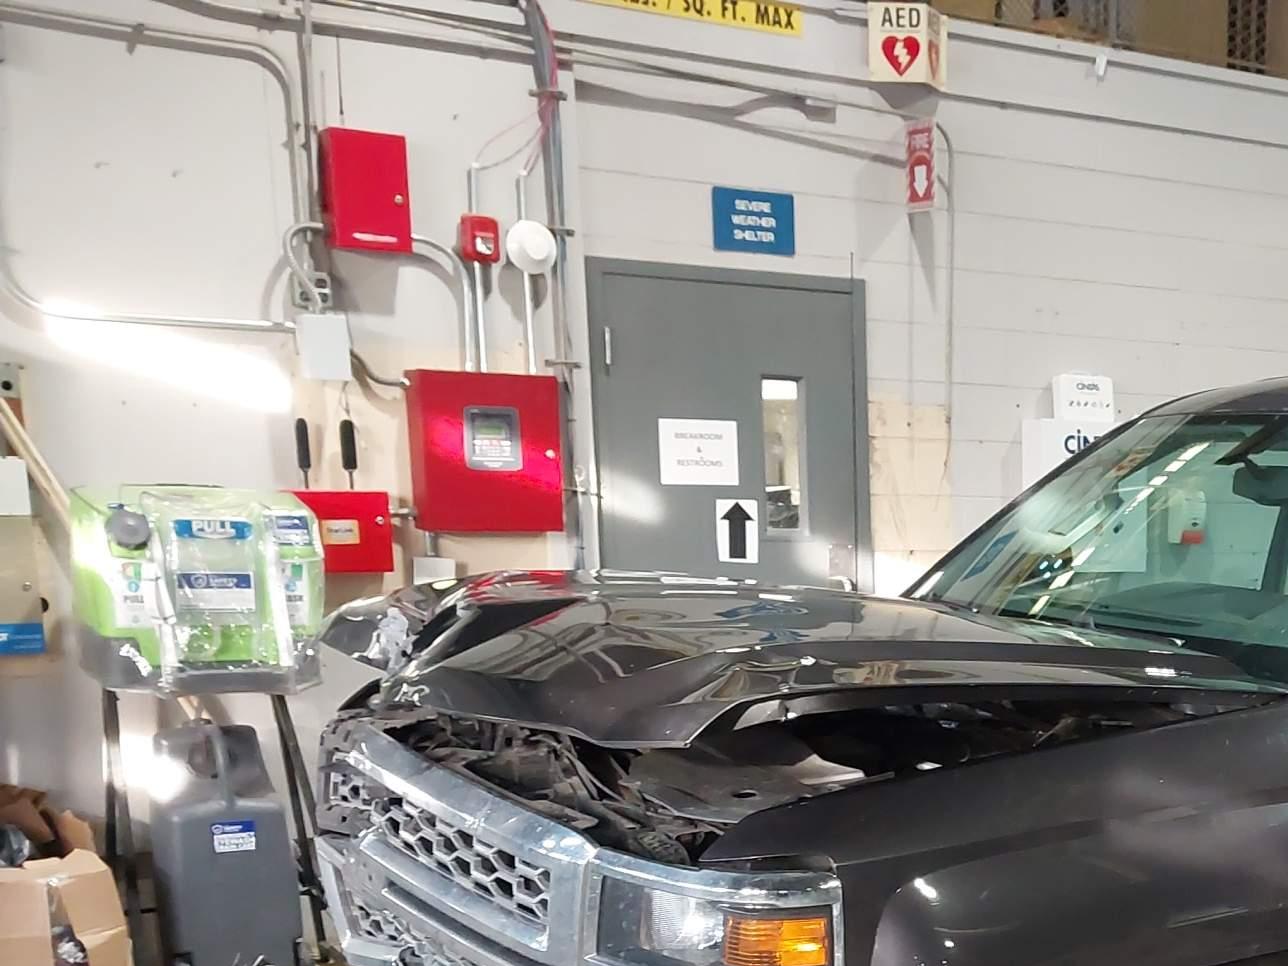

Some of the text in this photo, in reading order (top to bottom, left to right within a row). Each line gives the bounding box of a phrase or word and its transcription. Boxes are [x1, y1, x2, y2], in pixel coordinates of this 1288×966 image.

[721, 0, 746, 22] FT.
[755, 3, 795, 30] MAX
[881, 7, 921, 28] AED
[735, 199, 772, 213] SEVERE
[731, 214, 777, 228] WEATHER
[733, 229, 775, 243] SHELTER
[192, 519, 237, 533] PULL
